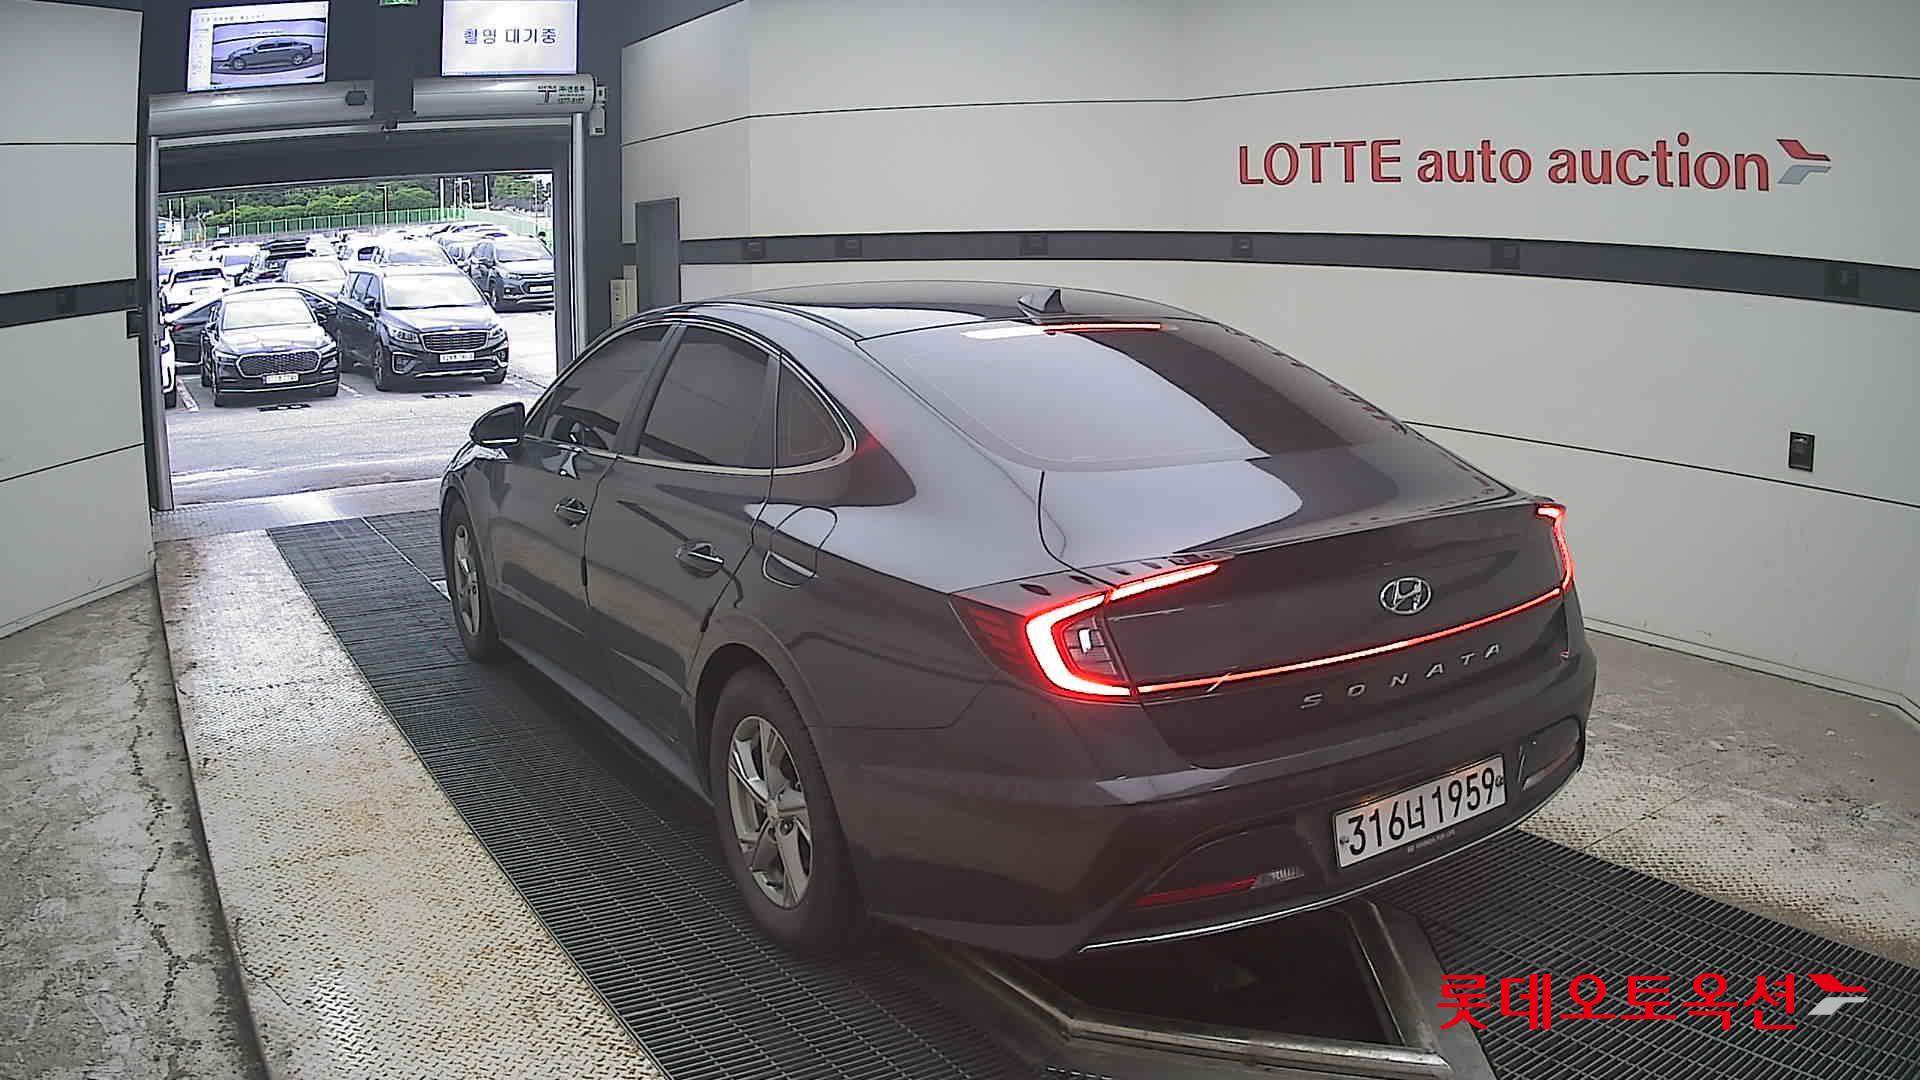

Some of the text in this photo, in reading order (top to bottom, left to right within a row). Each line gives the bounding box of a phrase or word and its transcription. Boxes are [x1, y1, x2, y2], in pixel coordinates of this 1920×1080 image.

[505, 28, 557, 45] 대기중
[1238, 132, 1770, 192] LOTTE auto auction
[1299, 643, 1503, 710] SONATA
